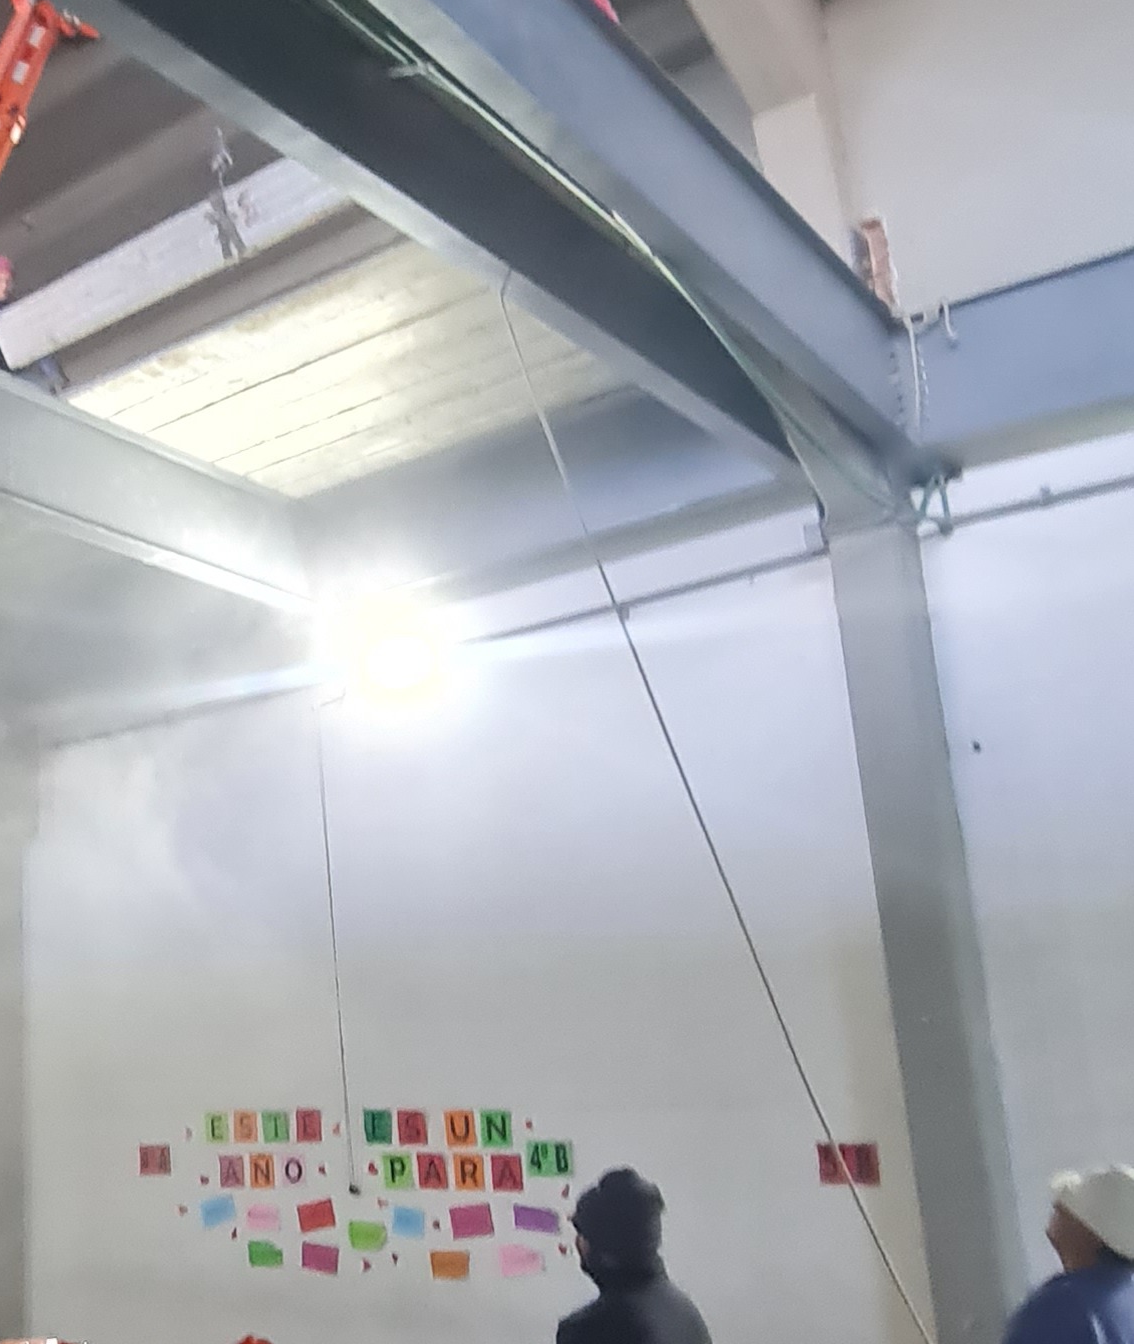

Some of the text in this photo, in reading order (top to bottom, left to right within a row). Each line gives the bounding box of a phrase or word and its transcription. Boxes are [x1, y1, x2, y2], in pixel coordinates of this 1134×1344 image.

[209, 1113, 319, 1141] ESTE
[449, 1114, 509, 1142] UN
[389, 1156, 518, 1189] PARA
